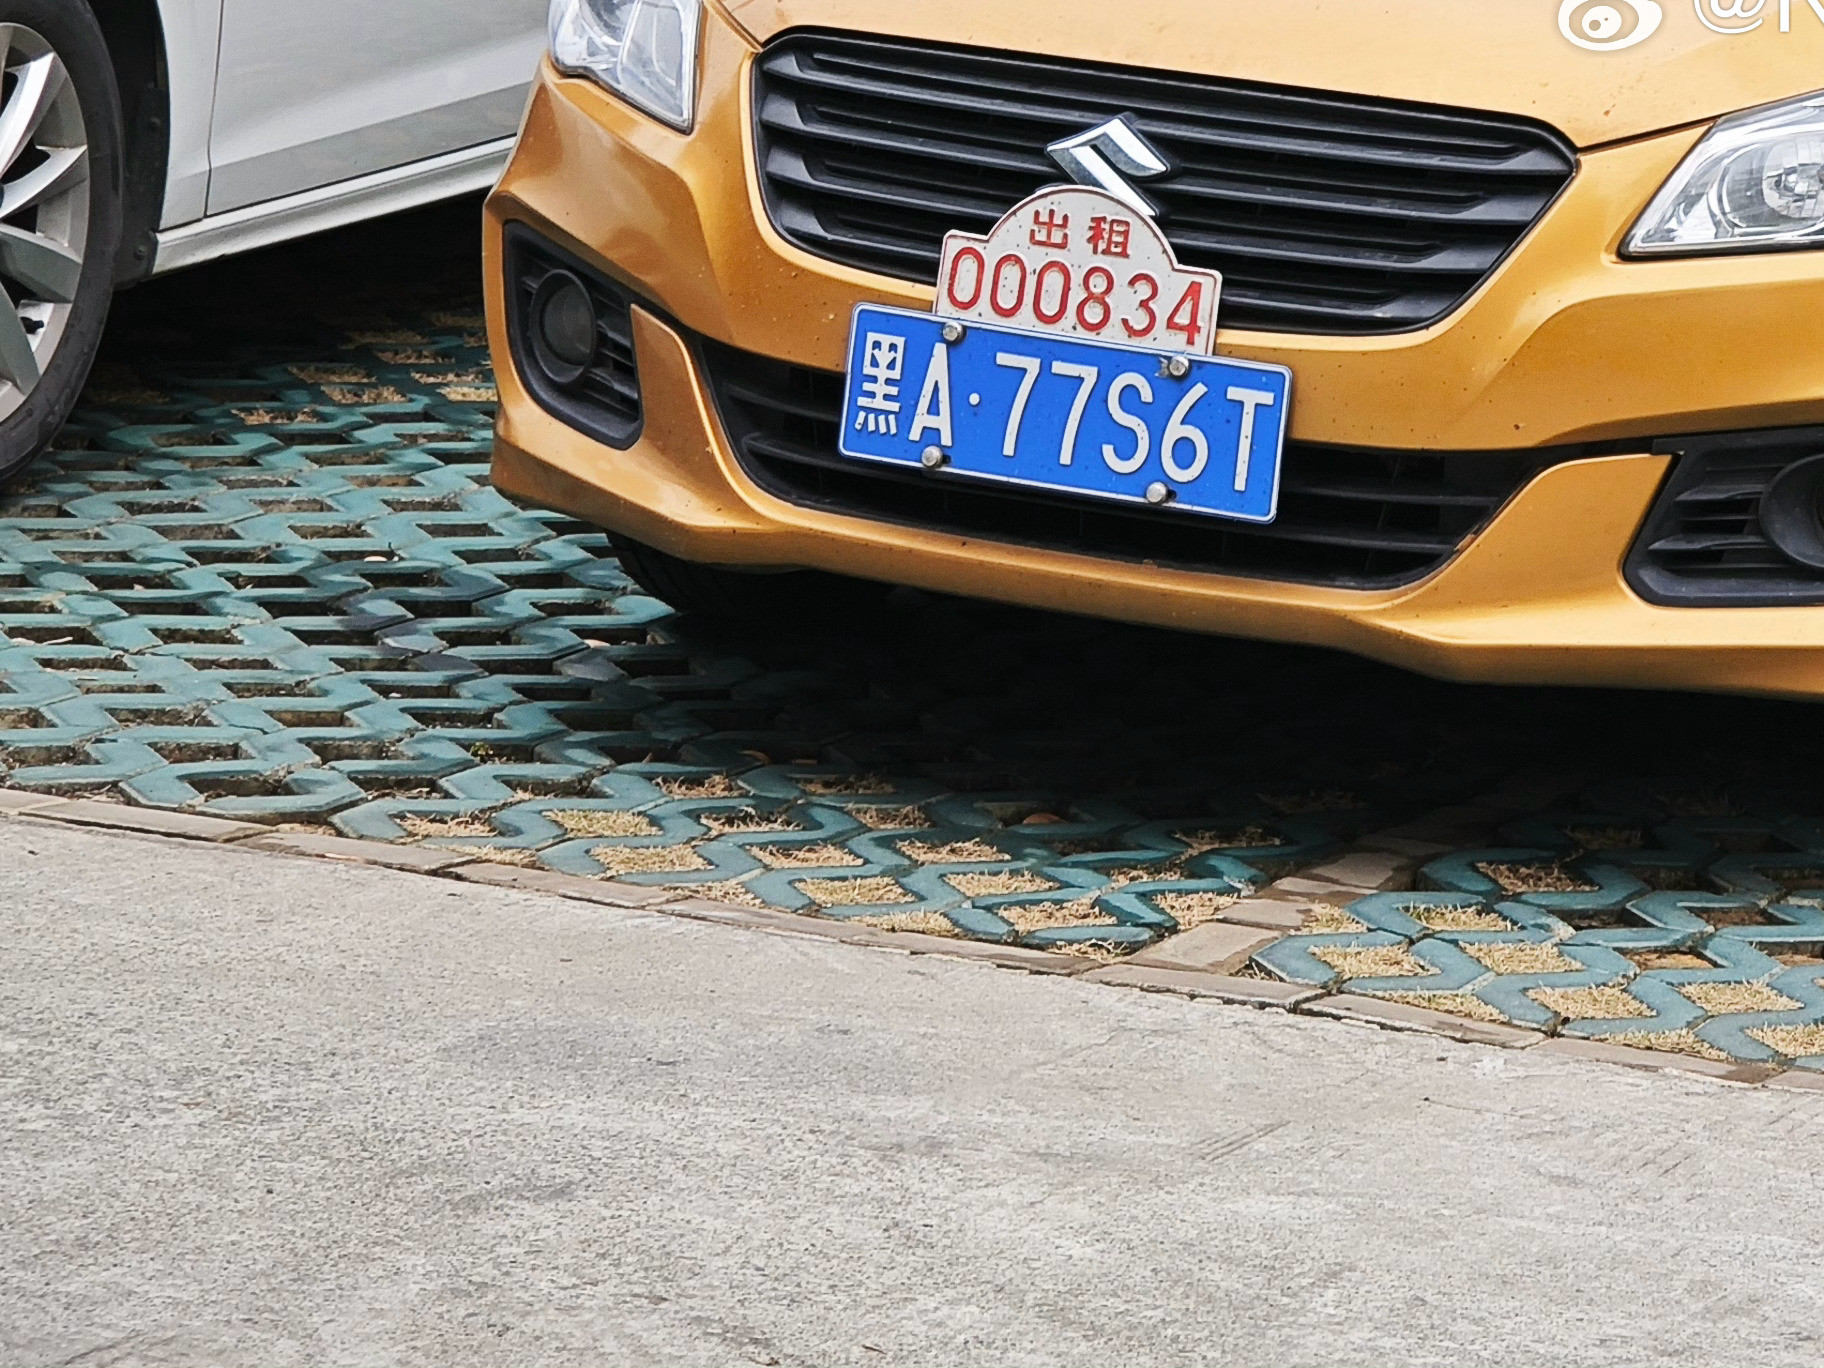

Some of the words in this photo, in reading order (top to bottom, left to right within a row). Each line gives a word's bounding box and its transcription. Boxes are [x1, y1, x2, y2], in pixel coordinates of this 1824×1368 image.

[1029, 208, 1132, 258] 出租
[946, 246, 1203, 345] 000834
[854, 331, 1276, 493] 黑A·77S6T
